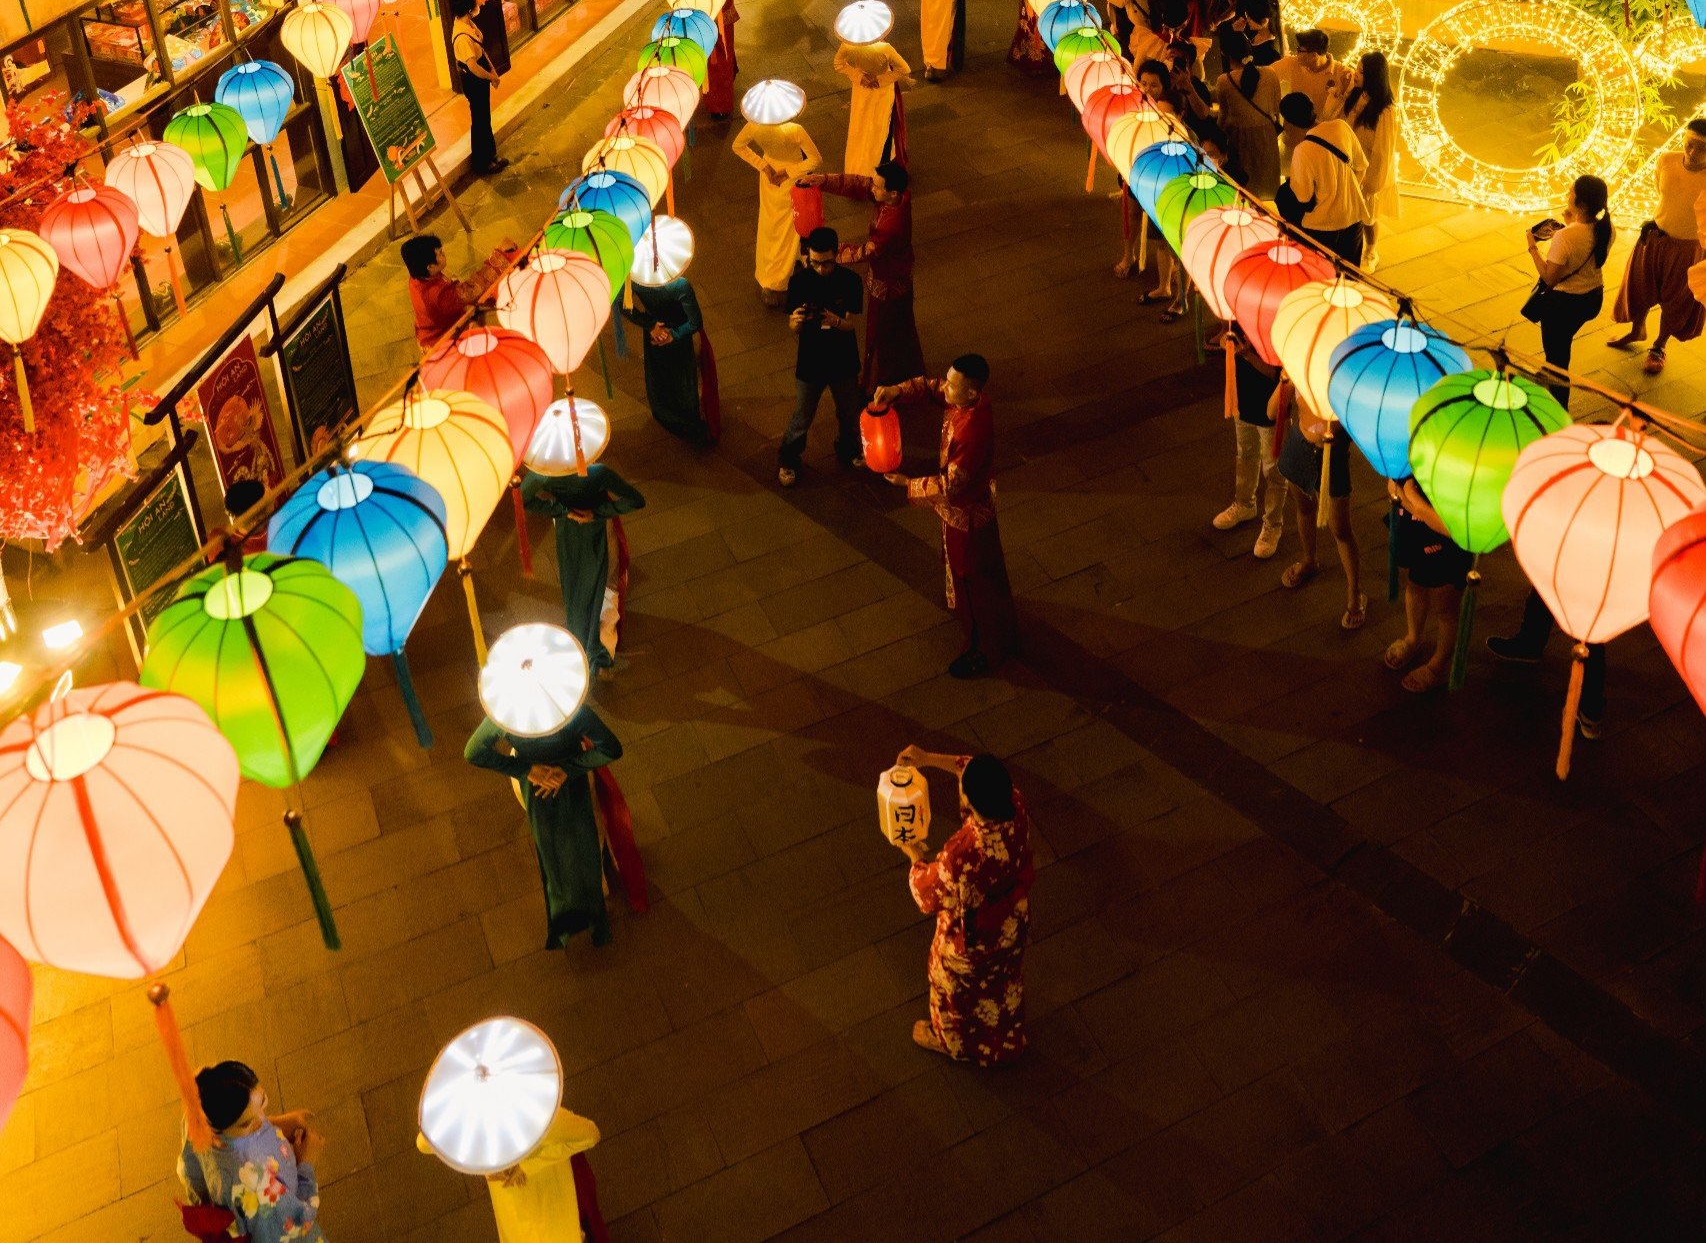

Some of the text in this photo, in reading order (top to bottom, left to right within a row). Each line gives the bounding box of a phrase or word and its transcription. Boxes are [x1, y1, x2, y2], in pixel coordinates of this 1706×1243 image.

[230, 361, 241, 378] AN
[155, 499, 166, 517] AN
[158, 501, 175, 522] LAND
